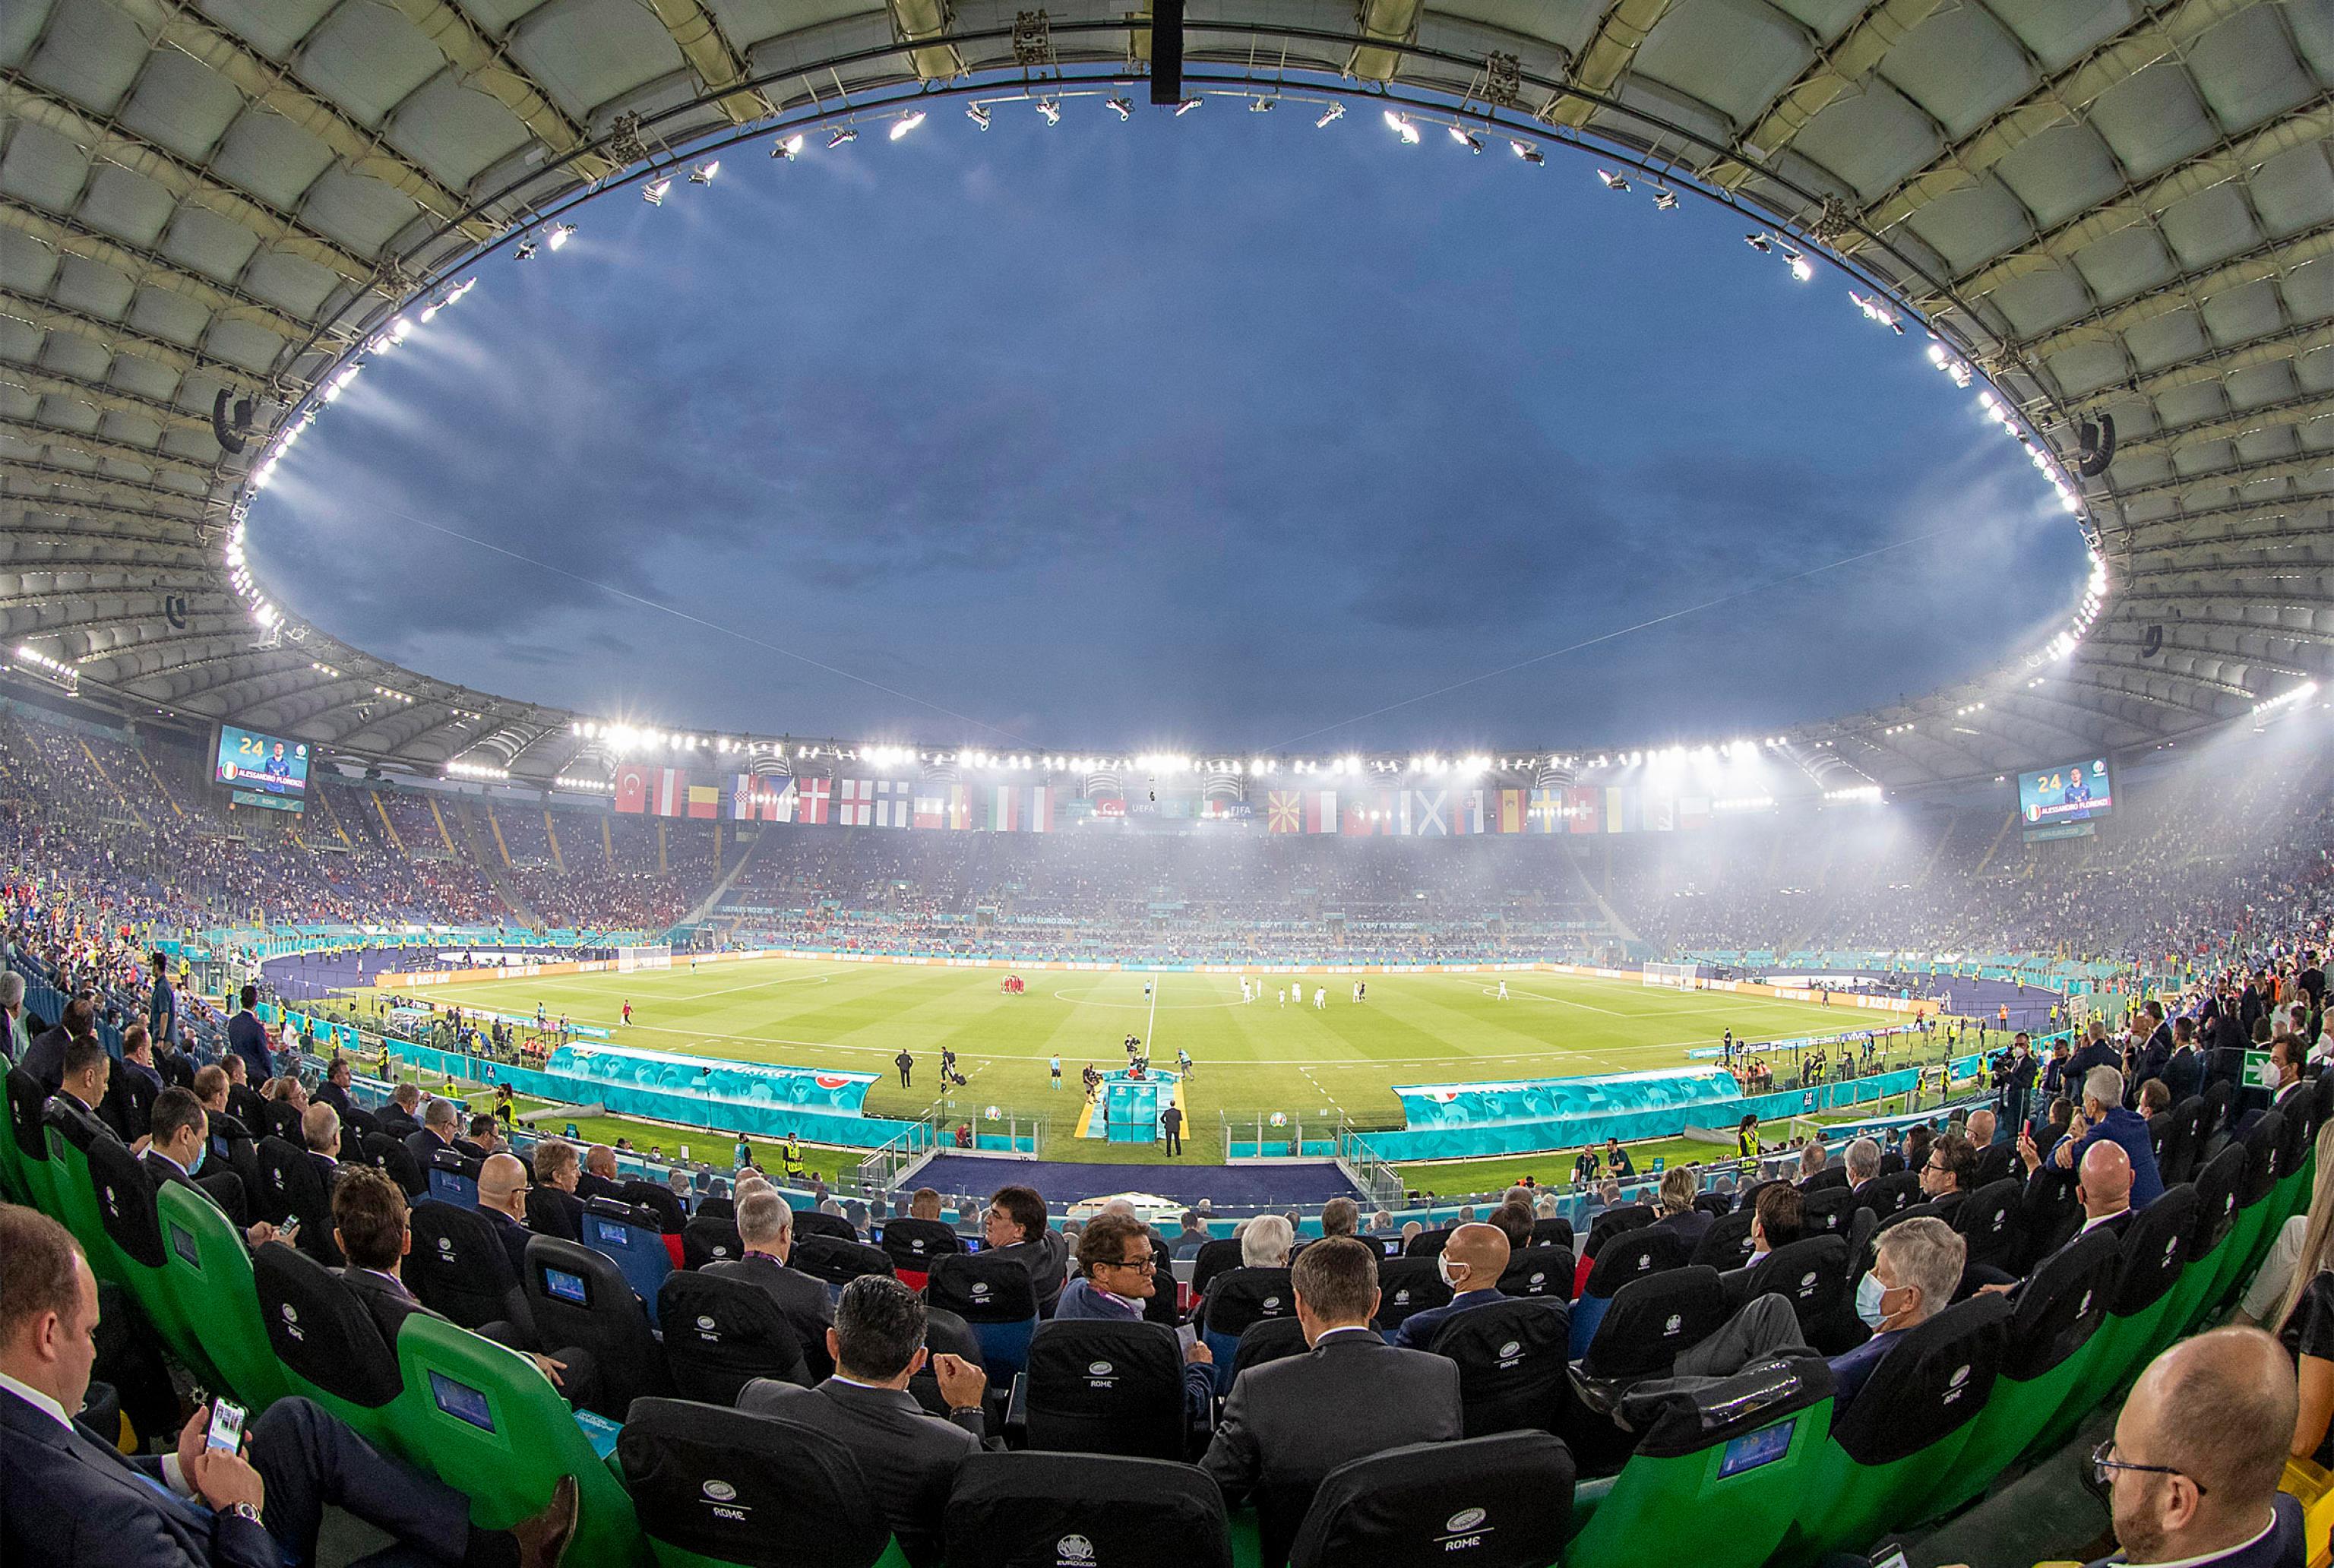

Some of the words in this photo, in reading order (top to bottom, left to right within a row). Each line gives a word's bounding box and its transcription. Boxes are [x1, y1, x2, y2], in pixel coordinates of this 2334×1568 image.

[240, 737, 264, 757] 24
[2038, 773, 2062, 793] 24
[1231, 806, 1251, 814] FIFA
[1867, 996, 1890, 1010] JUST
[1890, 998, 1911, 1011] EAT
[1847, 1032, 1867, 1040] vivo
[1500, 1358, 1520, 1369] ROME
[1090, 1380, 1113, 1388] ROME
[713, 1506, 745, 1521] ROME
[1445, 1536, 1480, 1551] ROME
